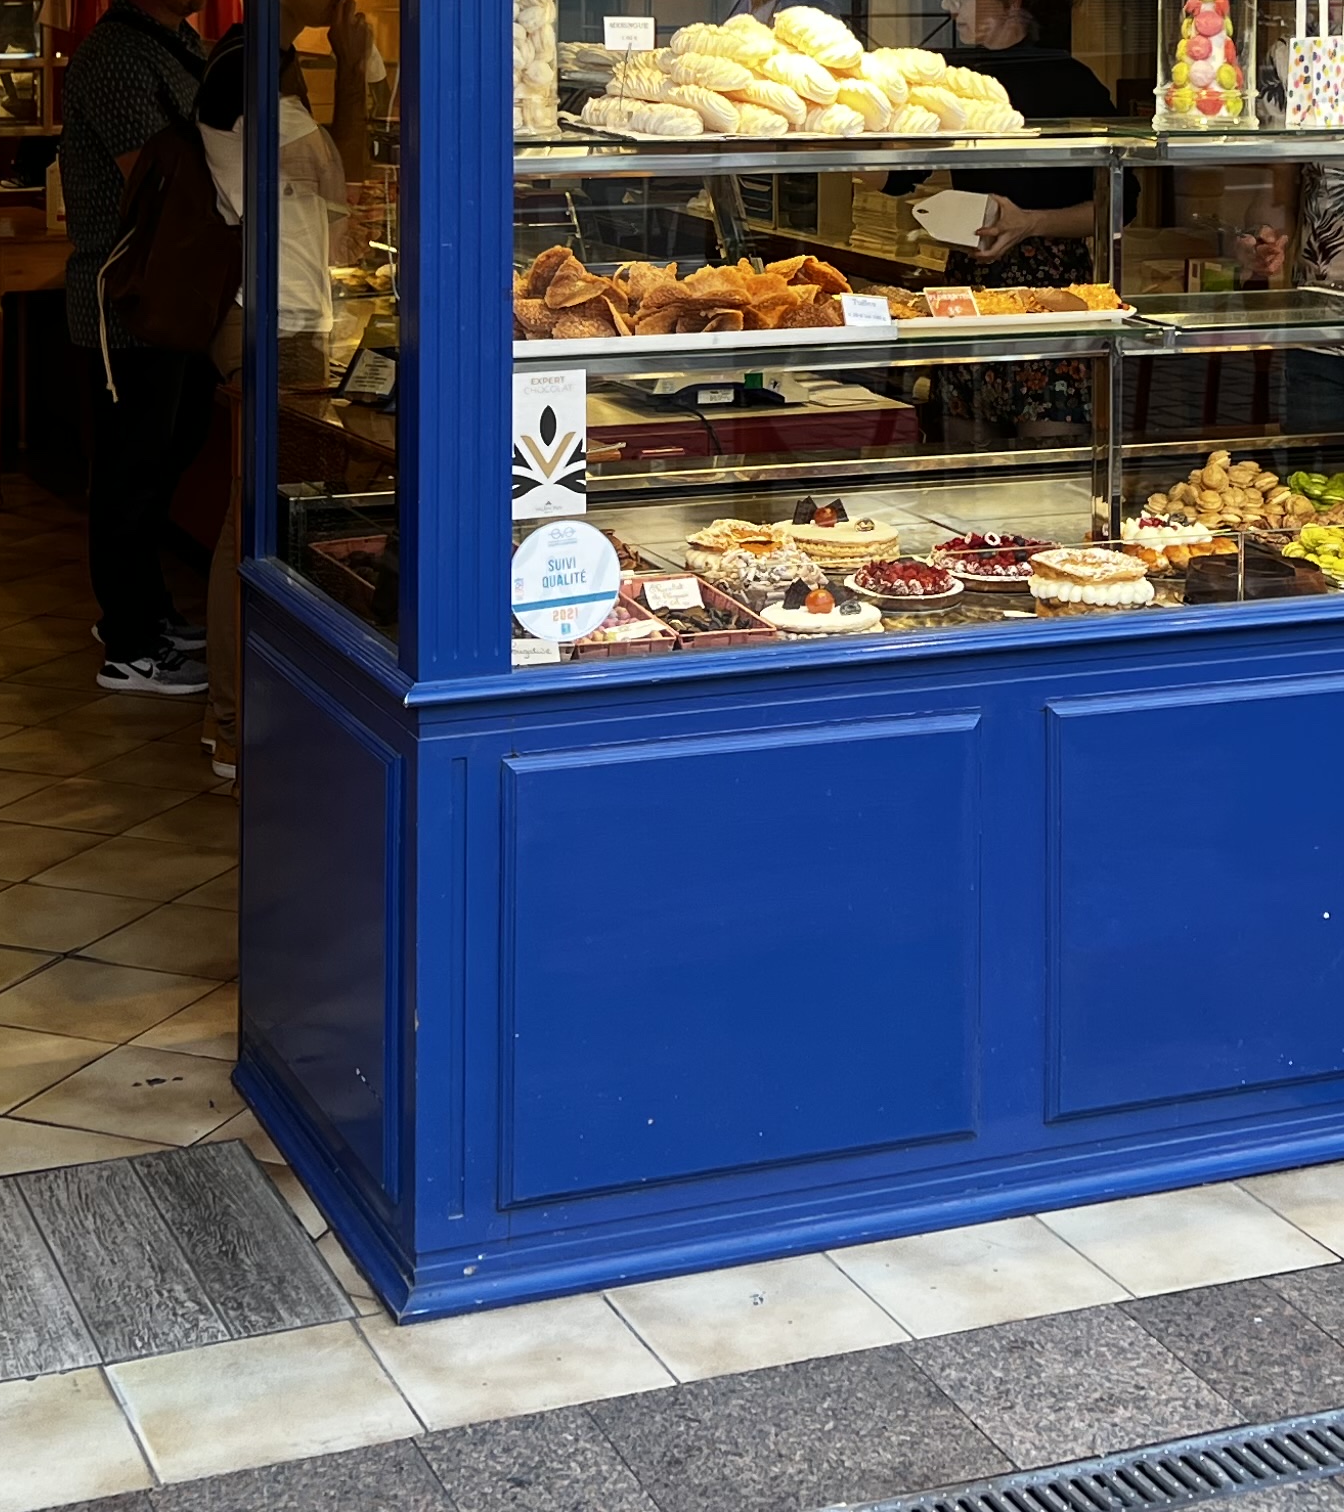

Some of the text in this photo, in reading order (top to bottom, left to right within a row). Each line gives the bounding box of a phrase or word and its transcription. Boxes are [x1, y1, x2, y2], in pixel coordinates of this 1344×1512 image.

[530, 375, 565, 386] EXPERT
[523, 383, 573, 395] CHOCOLAT
[548, 557, 576, 572] SUIVI
[542, 569, 587, 588] QUALITÉ
[552, 608, 578, 622] 2021
